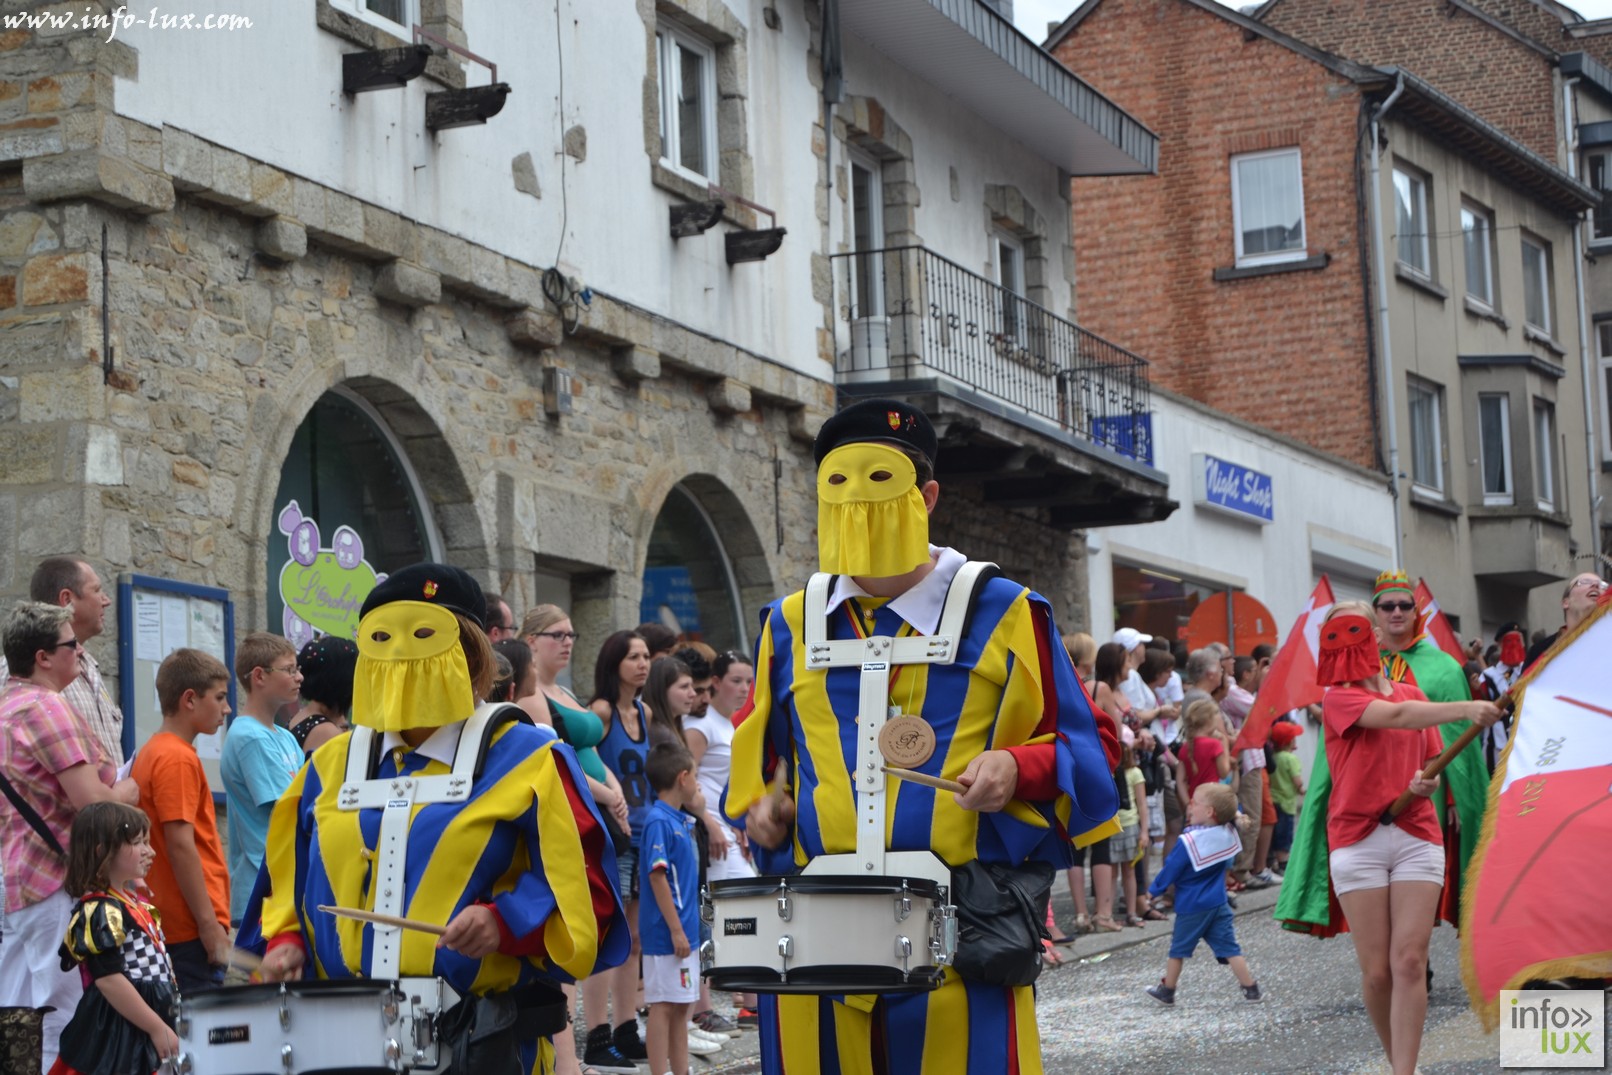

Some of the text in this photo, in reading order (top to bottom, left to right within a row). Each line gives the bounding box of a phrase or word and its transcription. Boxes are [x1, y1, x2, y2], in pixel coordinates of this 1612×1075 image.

[1206, 458, 1273, 515] Night Shop
[725, 920, 752, 933] Hayman
